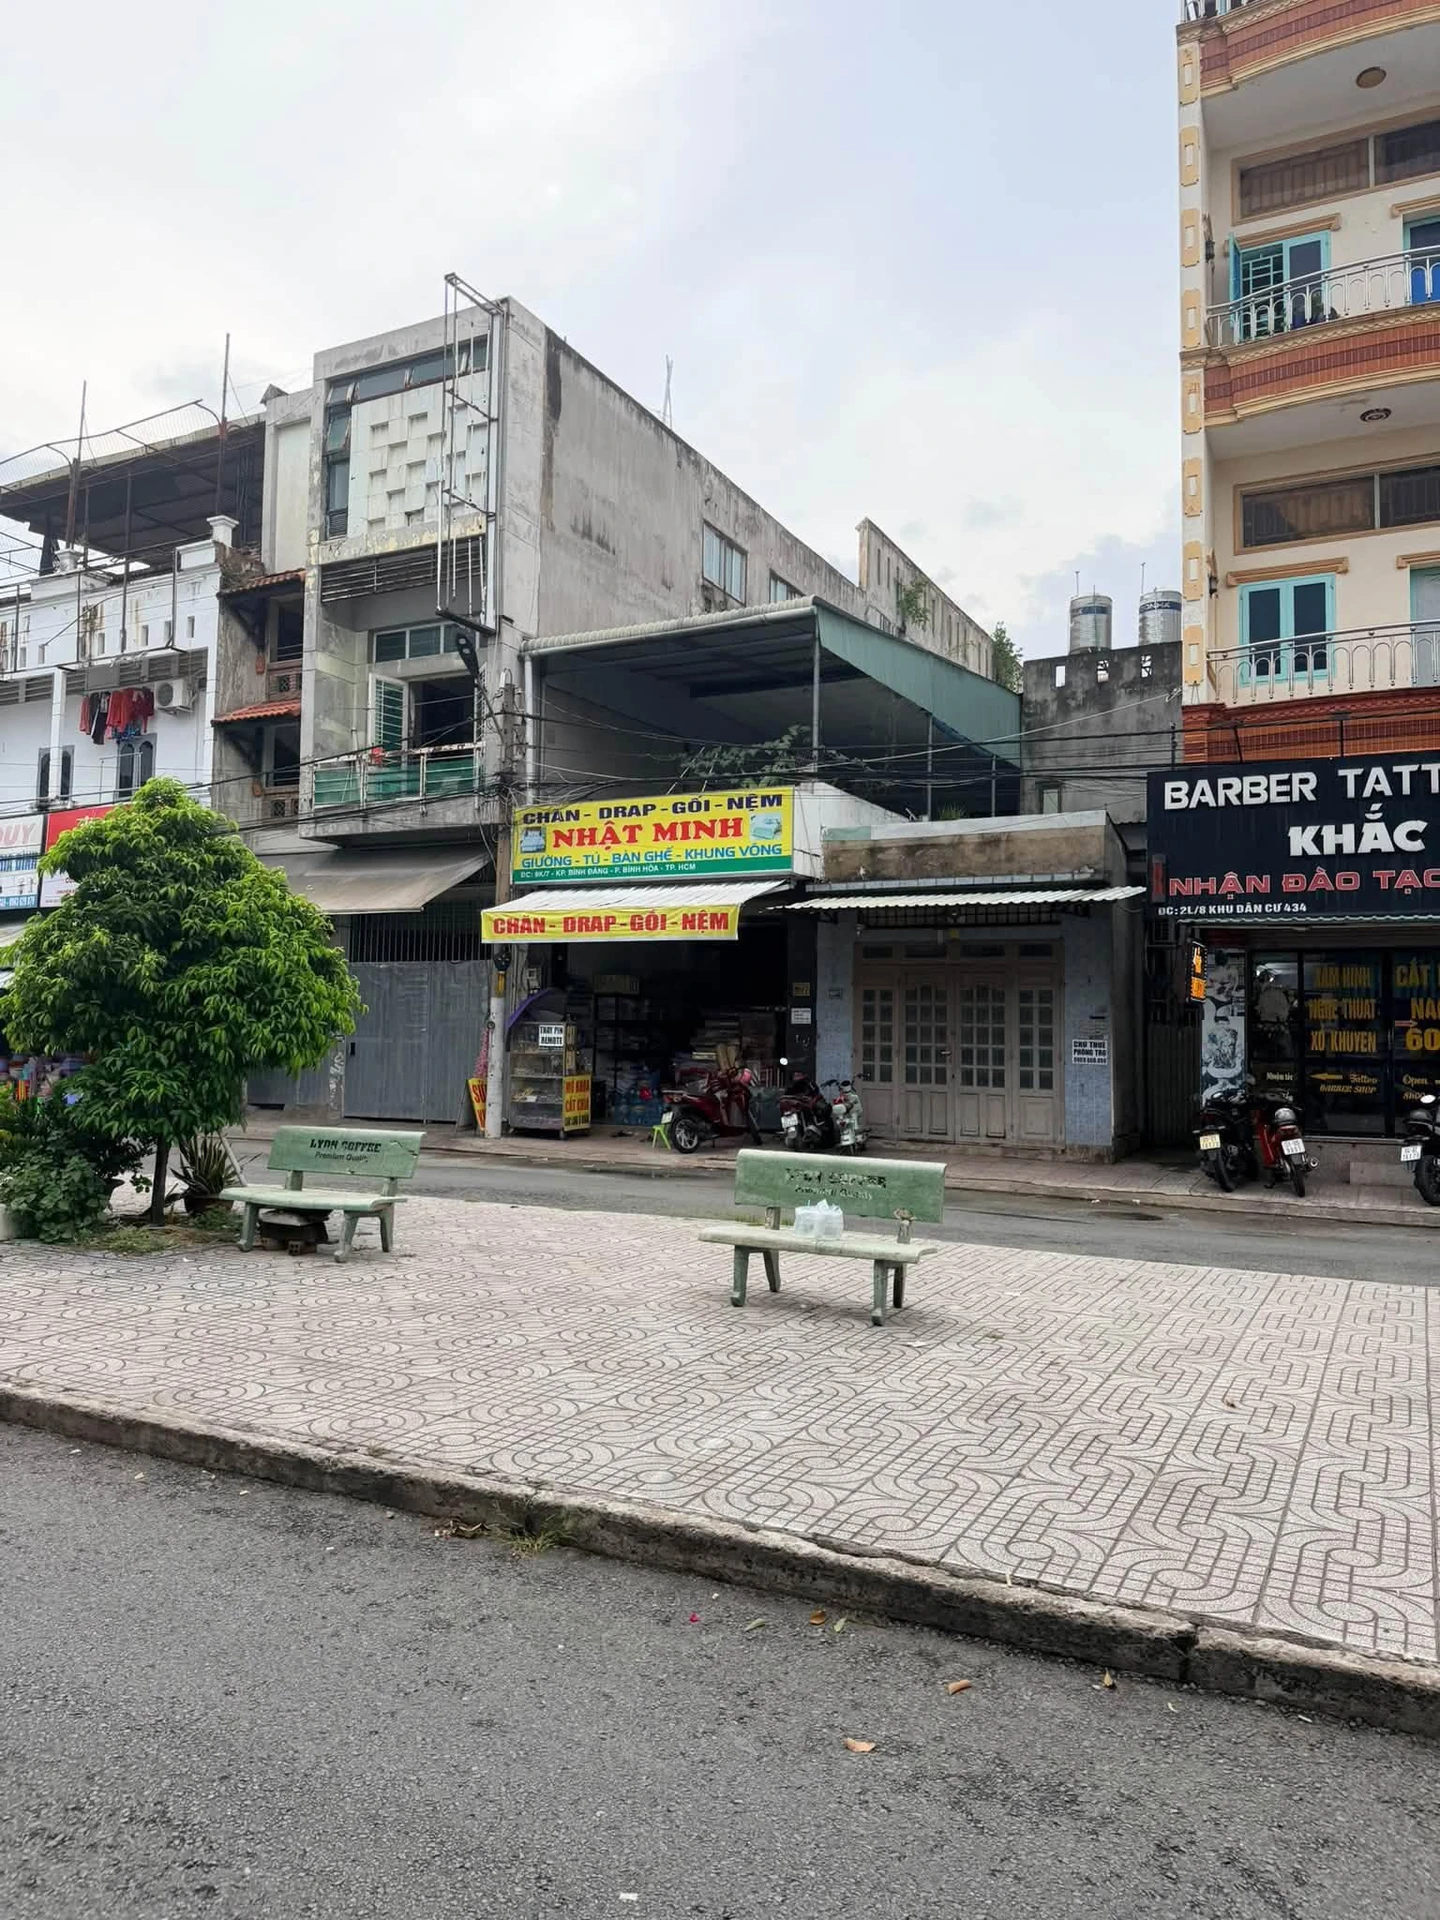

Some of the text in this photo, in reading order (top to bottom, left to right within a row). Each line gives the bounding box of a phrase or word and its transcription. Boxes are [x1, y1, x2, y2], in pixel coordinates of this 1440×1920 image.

[1164, 772, 1318, 810] BARBER
[599, 804, 656, 819] DRAP
[672, 796, 710, 814] GỐI
[727, 794, 782, 811] NỆM
[553, 817, 743, 850] NHẬT MINH
[1288, 803, 1428, 856] KHẮC
[522, 854, 572, 868] GIƯỜNG
[583, 852, 600, 864] TỦ
[612, 850, 640, 863] BÀN
[644, 846, 674, 862] GHẾ
[685, 846, 735, 860] KHUNG
[740, 843, 782, 857] VÕNG
[678, 862, 696, 871] HCM
[1169, 871, 1270, 900] NHẬN
[1282, 866, 1360, 892] ĐÀO
[1209, 904, 1233, 914] KHU
[1236, 902, 1262, 914] DÂN
[1265, 902, 1282, 913] CƯ
[1284, 903, 1307, 912] 434
[493, 914, 545, 934] CHĂN
[563, 915, 616, 933] DRAP
[629, 910, 668, 931] GỐI
[681, 910, 729, 933] NỆM
[342, 1140, 381, 1153] COFFEE
